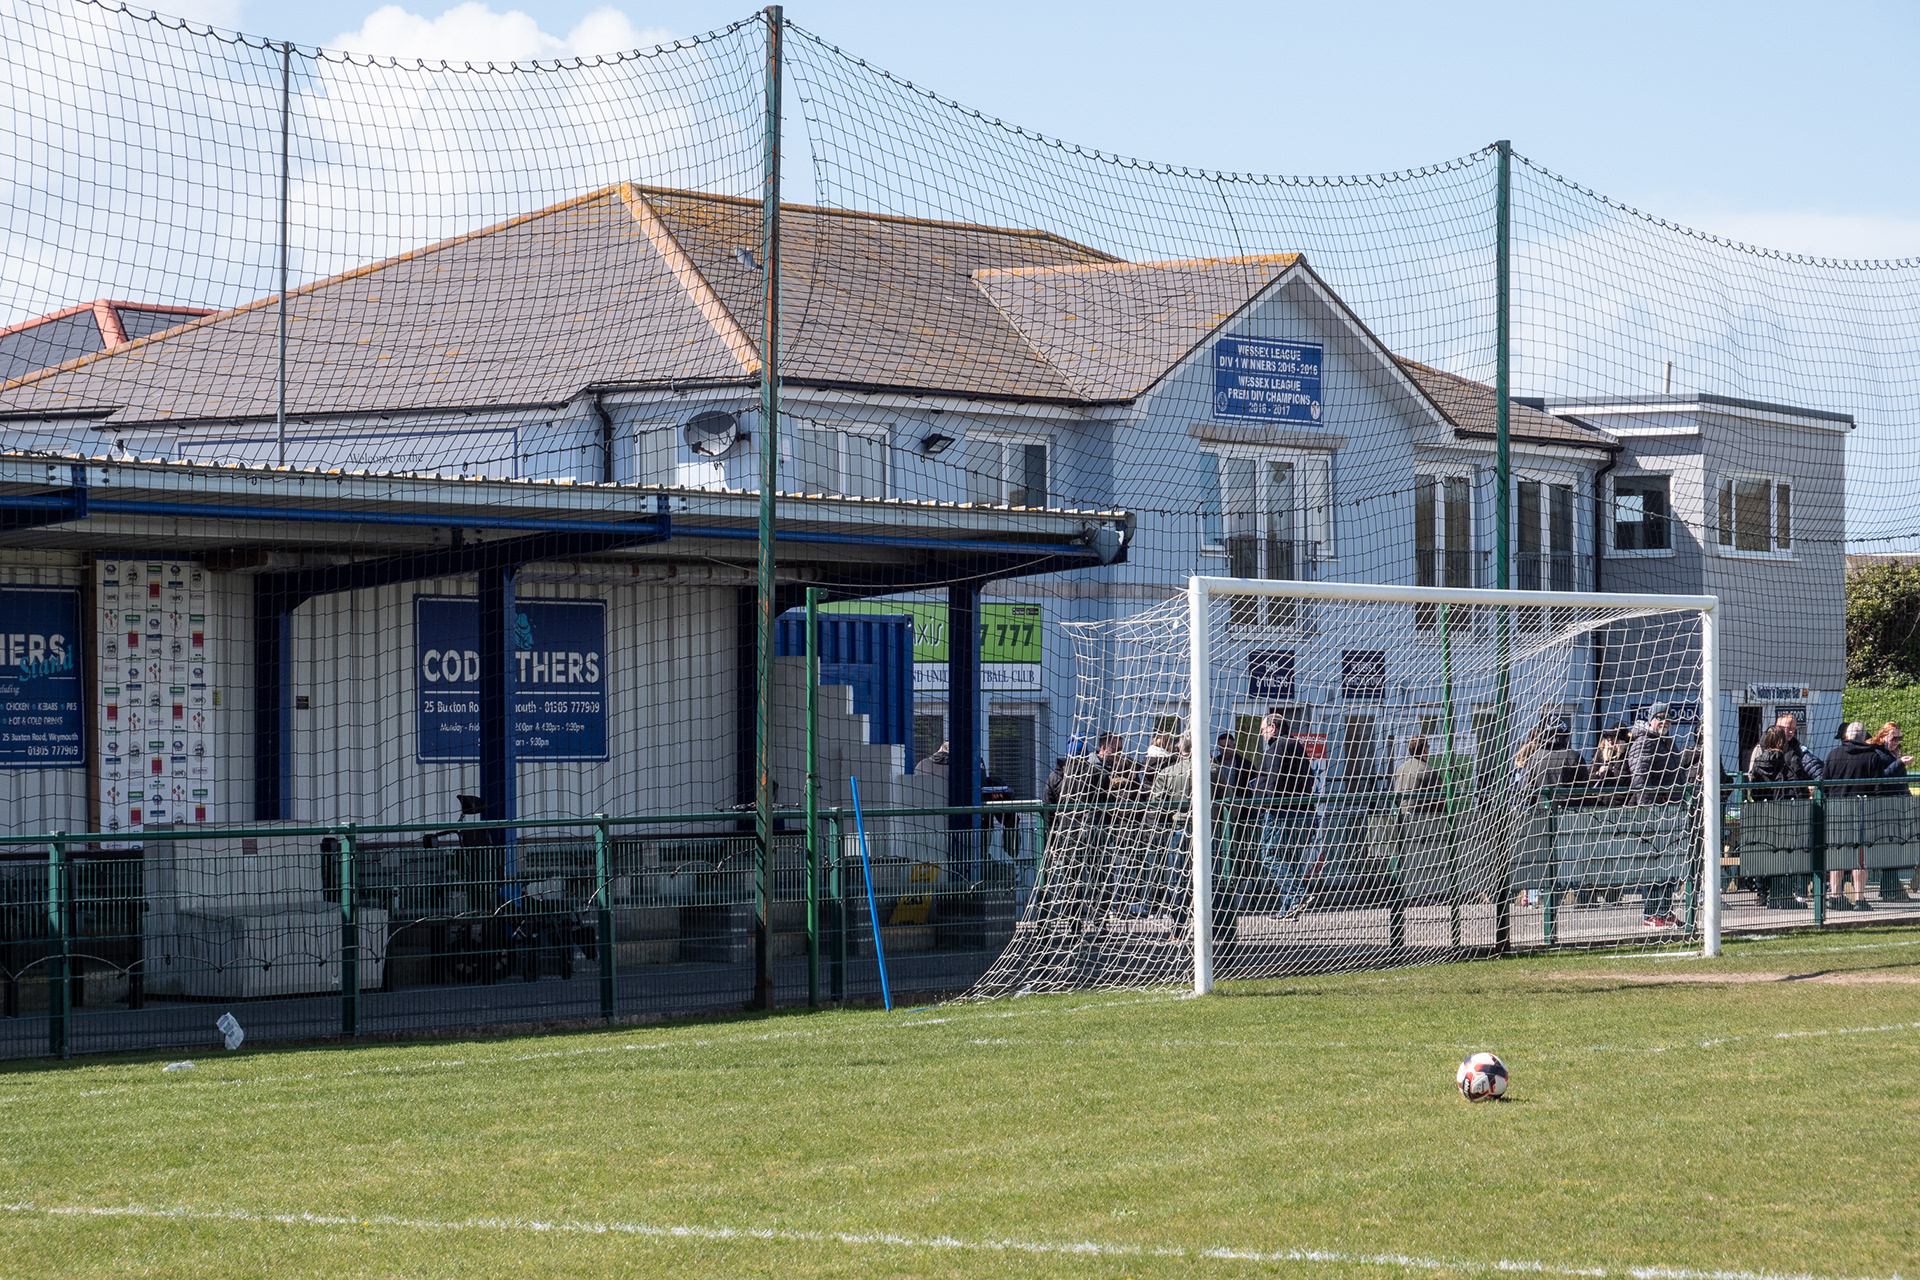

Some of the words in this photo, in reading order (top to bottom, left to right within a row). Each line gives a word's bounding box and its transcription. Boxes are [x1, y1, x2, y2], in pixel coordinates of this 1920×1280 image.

[1237, 344, 1269, 358] WESSEX
[1271, 348, 1301, 361] LEAGUE
[1220, 356, 1233, 367] DIV
[1235, 358, 1239, 368] 1
[1241, 358, 1276, 372] WNNERS
[1277, 362, 1296, 374] 2015
[1300, 364, 1318, 375] 2016
[1238, 375, 1270, 388] WESSEX
[1271, 379, 1301, 391] LEAGUE
[1227, 387, 1249, 400] PREM
[1251, 390, 1264, 402] DIV
[1266, 392, 1311, 405] CHAMPIONS
[1249, 402, 1267, 413] 2016
[1273, 404, 1290, 415] 2017
[349, 453, 394, 464] Welcome
[997, 624, 1034, 646] 777
[19, 643, 74, 682] Stand
[423, 649, 600, 684] CODTHERS
[927, 670, 949, 683] UNIT
[1012, 670, 1035, 683] CLUB
[5, 702, 30, 711] CHICKEN
[37, 702, 58, 711] KEBABS
[424, 700, 434, 713] 25
[437, 700, 466, 713] Buxton
[469, 701, 480, 713] Ro
[544, 701, 568, 713] 01305
[571, 701, 600, 713] 777909
[1670, 708, 1694, 719] OOD
[8, 717, 20, 725] HOT
[27, 717, 43, 726] COLD
[43, 717, 63, 726] DRINKS
[2, 733, 10, 741] 25
[11, 733, 31, 742] Buxton
[48, 733, 78, 743] Weymouth
[27, 746, 49, 756] 01305
[51, 745, 79, 756] 777909
